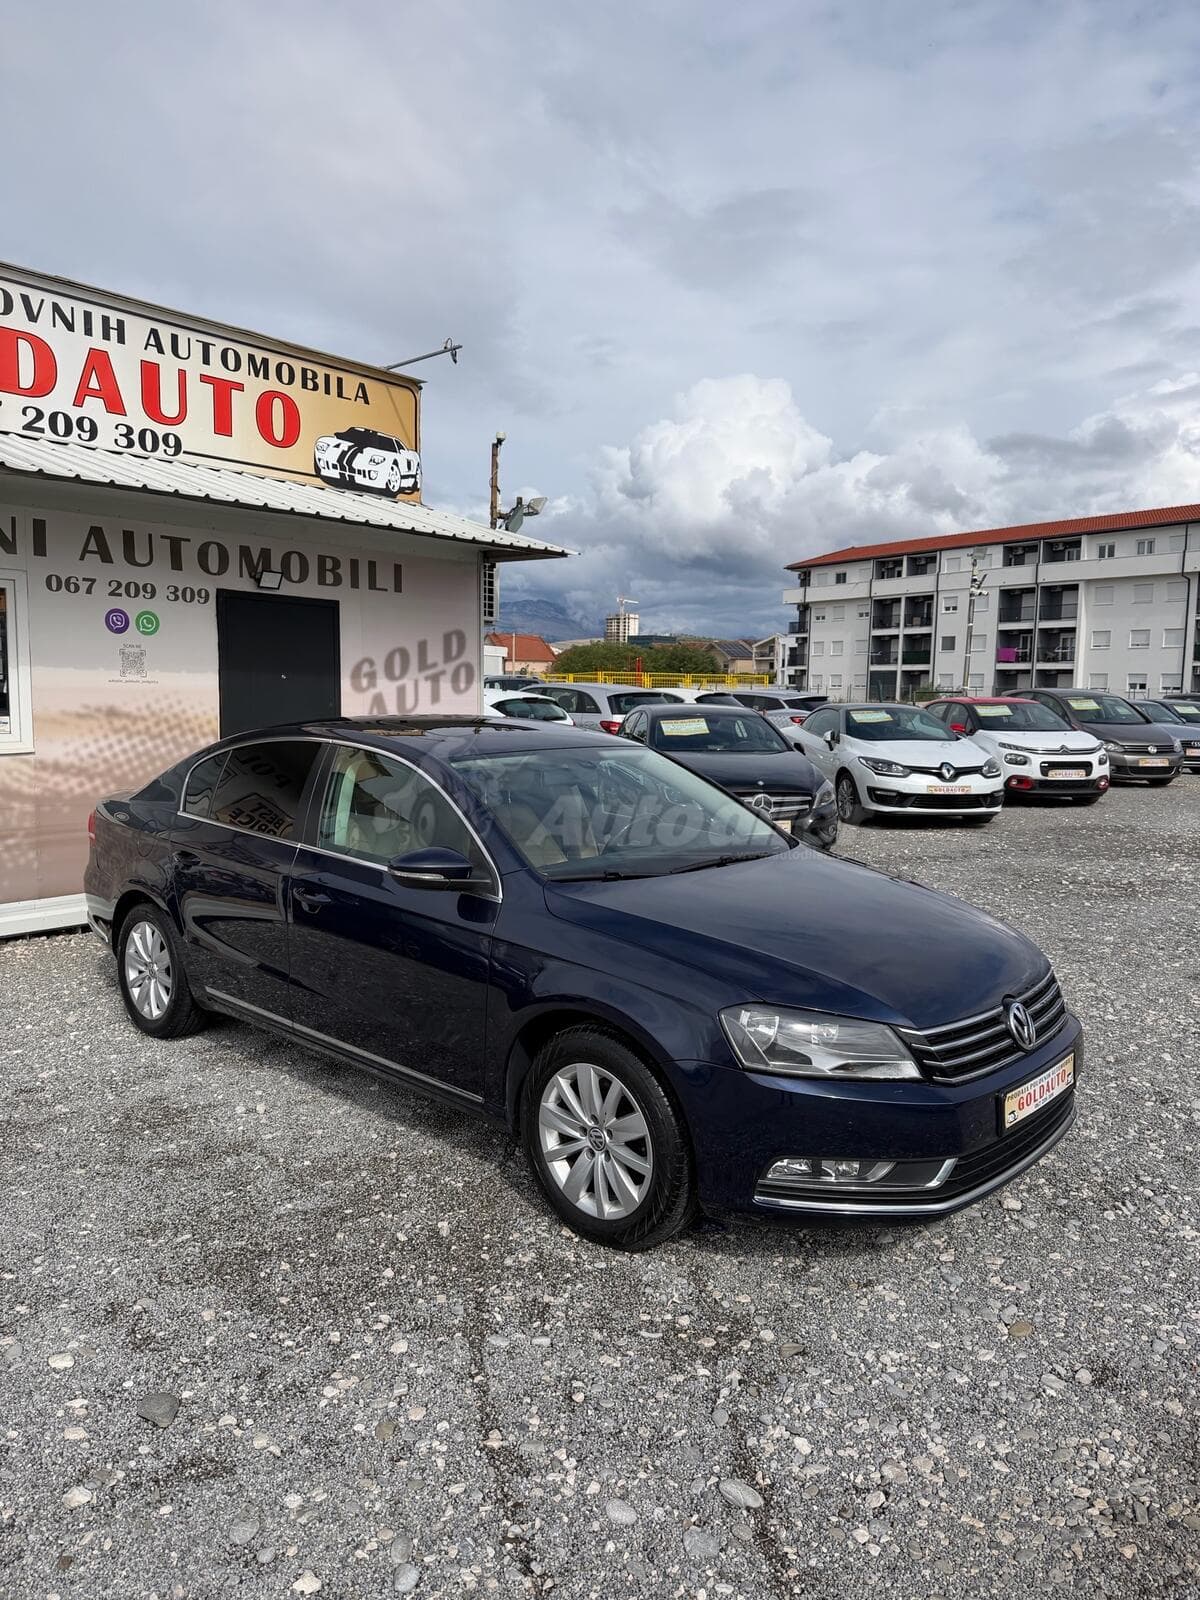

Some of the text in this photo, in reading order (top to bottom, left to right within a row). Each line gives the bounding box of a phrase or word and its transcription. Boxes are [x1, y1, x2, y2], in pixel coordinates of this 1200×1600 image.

[0, 325, 301, 449] DAUTO
[144, 327, 370, 405] AUTOMOBILA
[21, 405, 183, 457] 209 309
[45, 574, 210, 605] 067 209 309
[79, 526, 403, 593] AUTOMOBILI
[350, 628, 467, 694] GOLD
[367, 660, 475, 715] AUTO
[1018, 1069, 1066, 1111] GOLDAUTO
